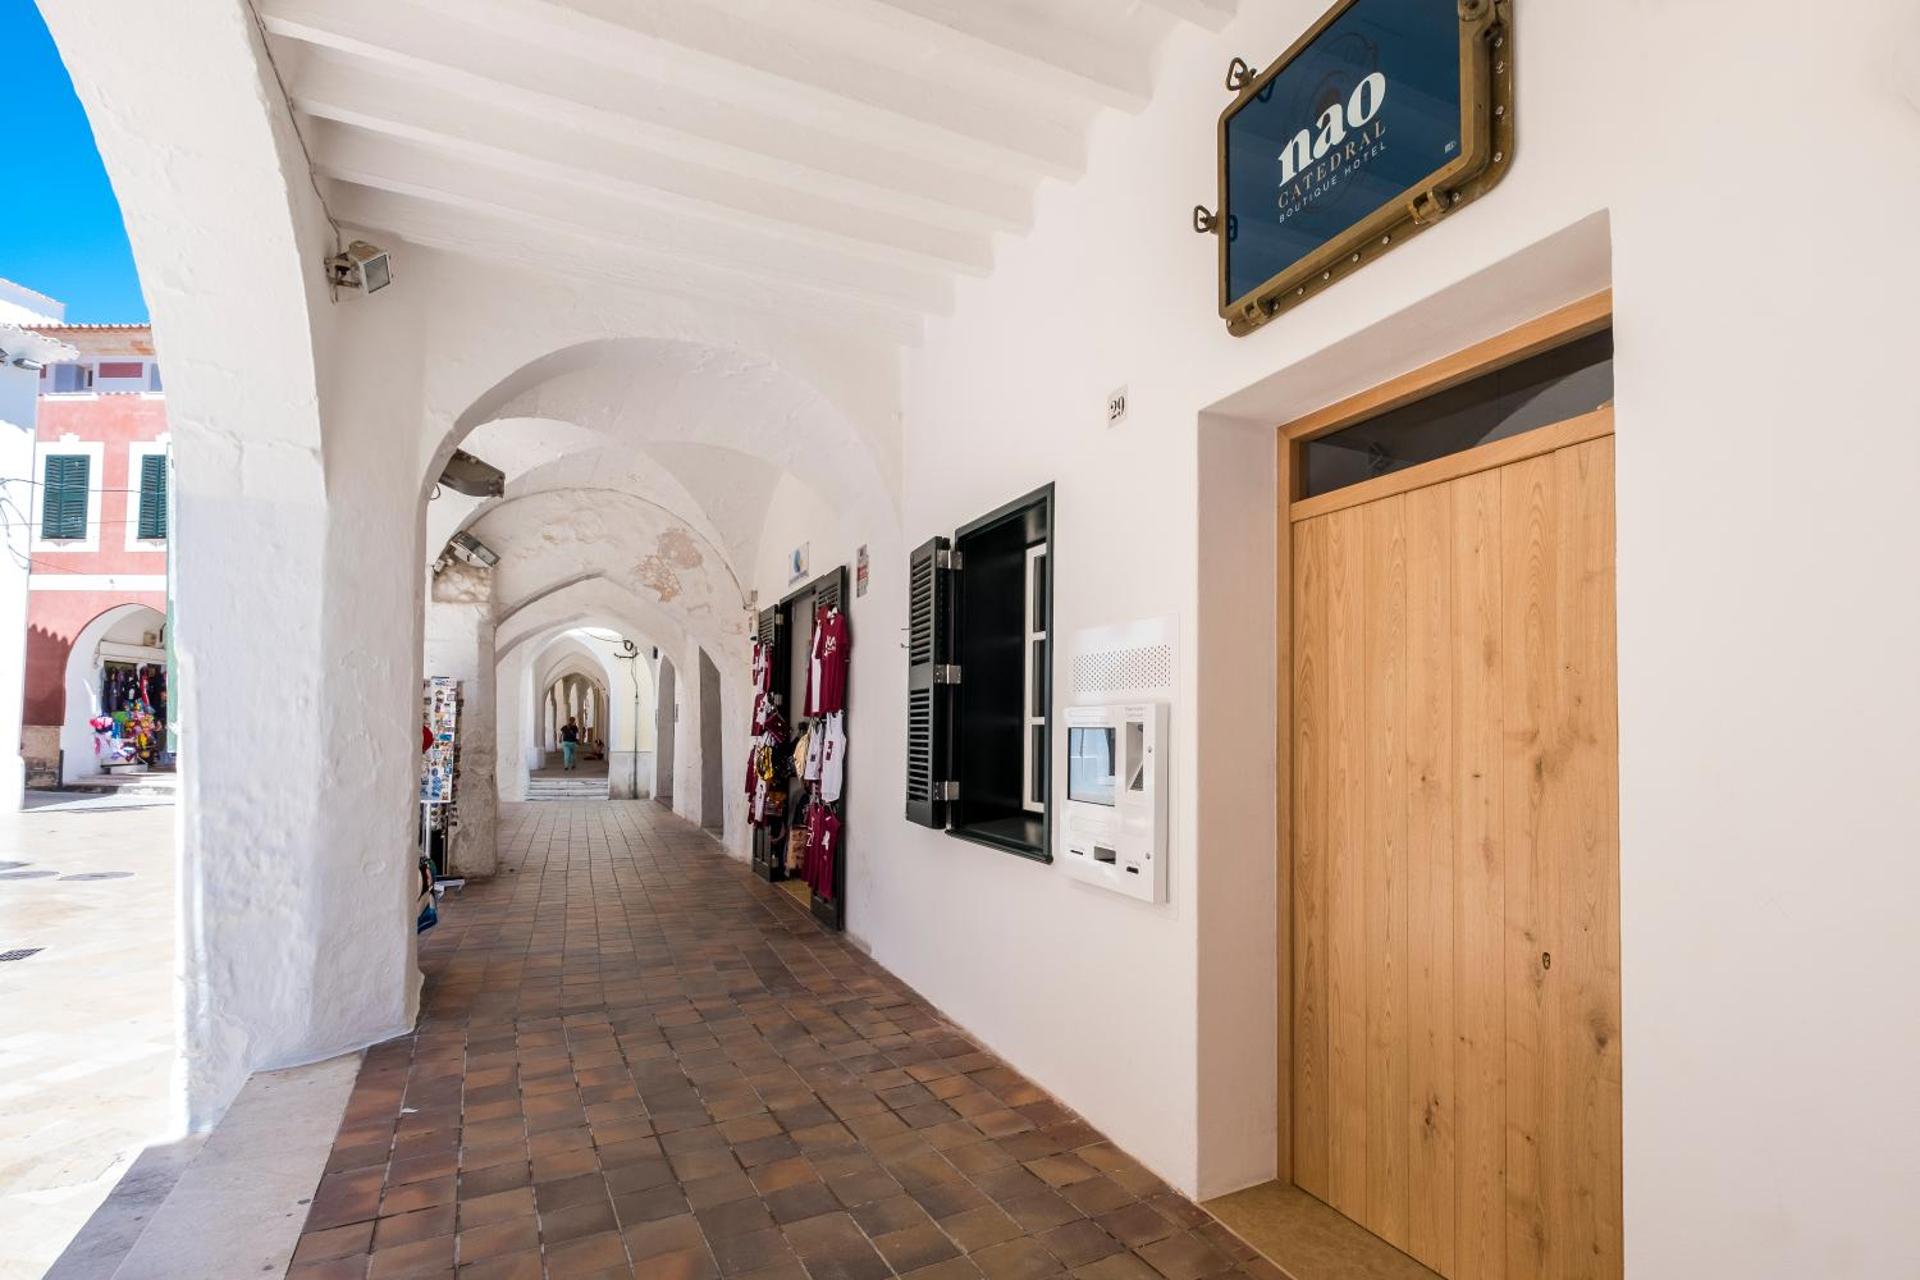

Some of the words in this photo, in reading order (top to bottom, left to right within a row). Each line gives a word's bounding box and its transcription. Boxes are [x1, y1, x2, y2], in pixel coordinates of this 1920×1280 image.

[1278, 72, 1386, 187] nao
[1278, 121, 1386, 208] CATEDRAL
[1279, 174, 1337, 223] BOUTIQUE
[1344, 142, 1386, 175] HOTEL
[1110, 395, 1125, 420] 29
